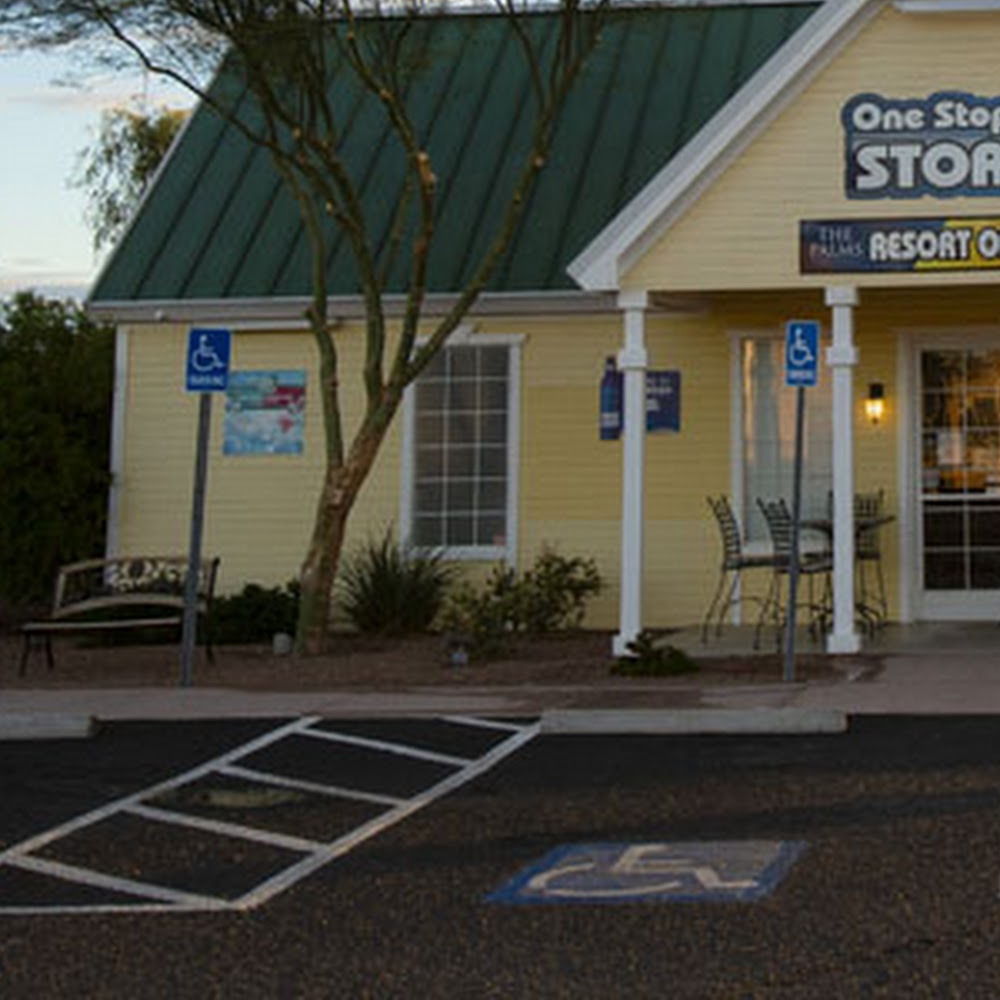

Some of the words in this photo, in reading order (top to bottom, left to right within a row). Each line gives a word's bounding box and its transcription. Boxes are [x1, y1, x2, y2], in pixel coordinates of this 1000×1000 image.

[853, 102, 925, 131] One
[819, 226, 852, 242] THE
[869, 228, 972, 261] RESORT
